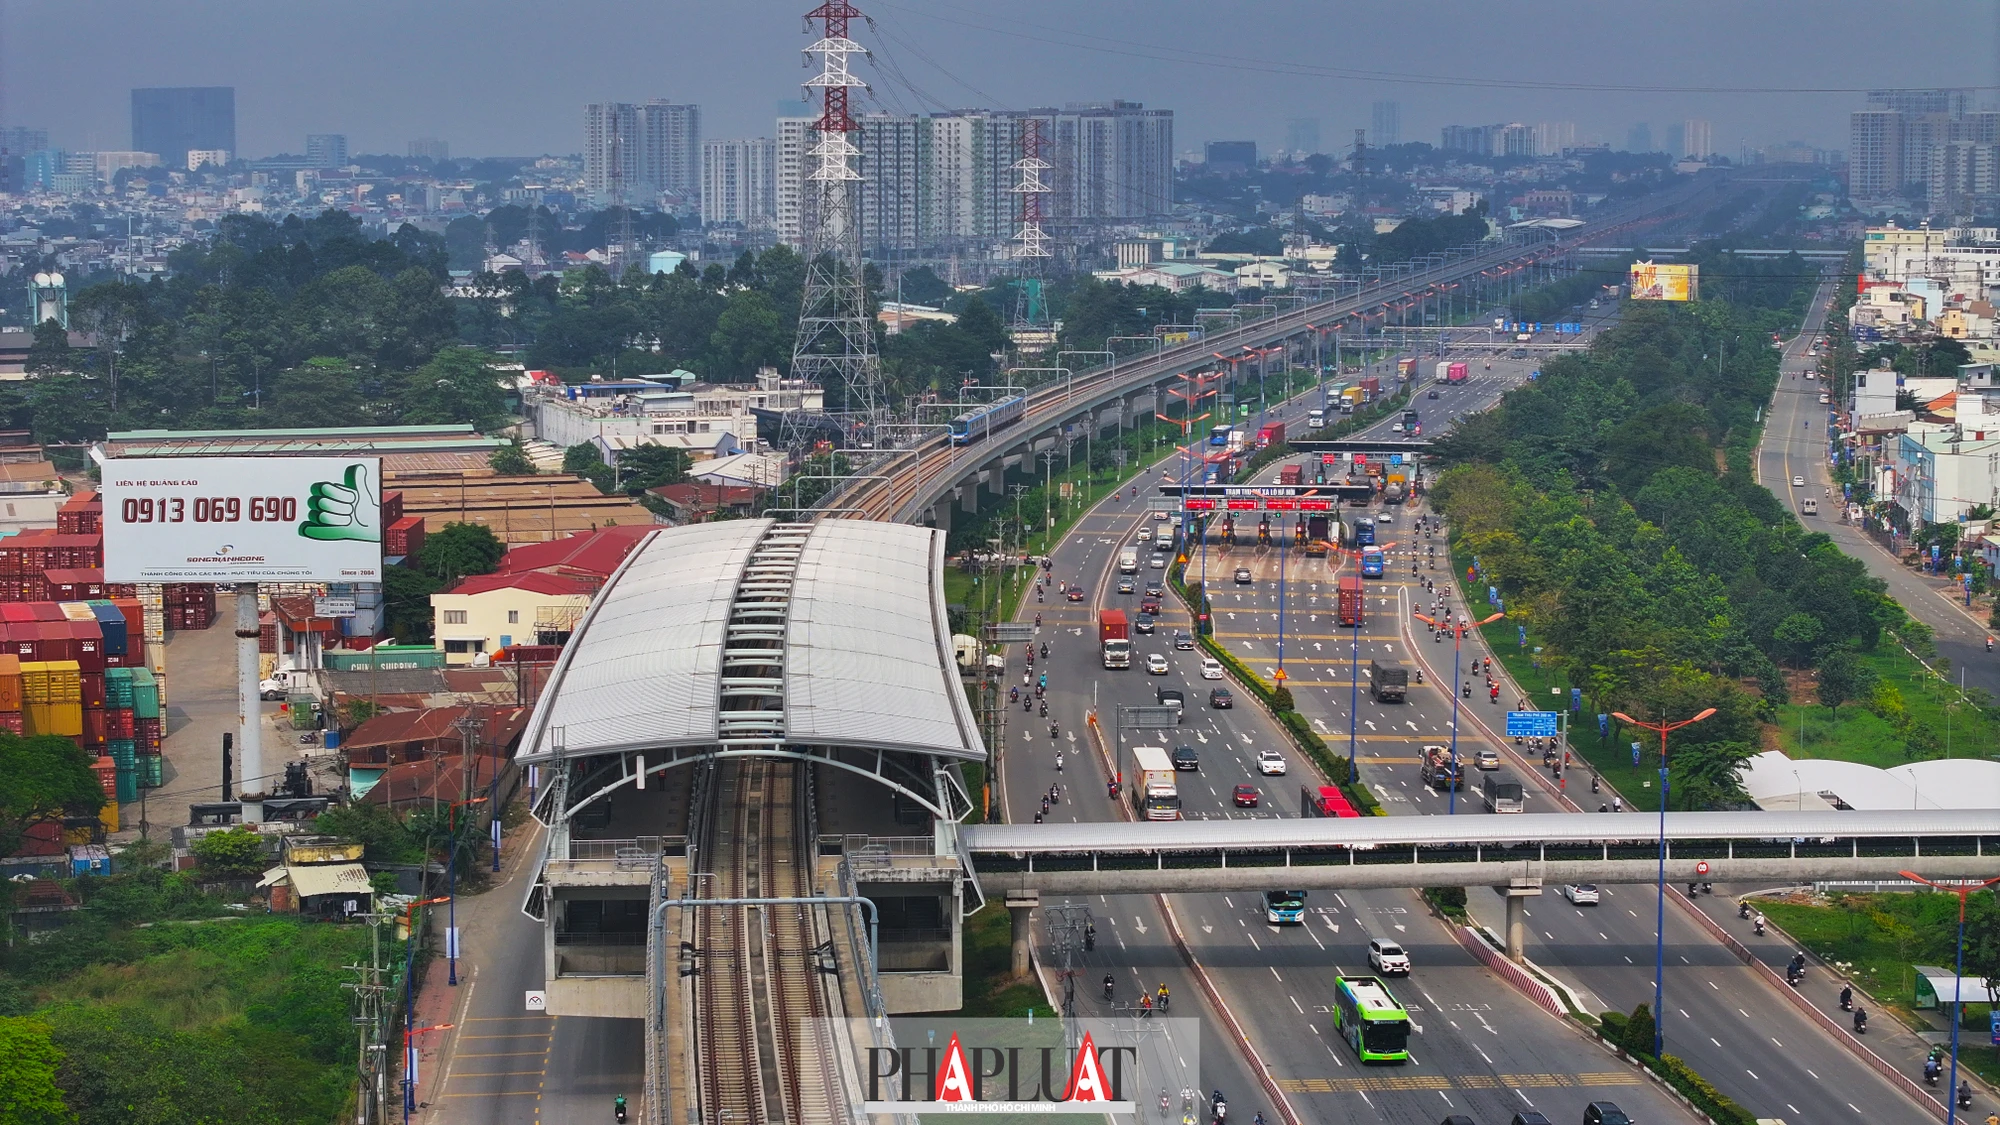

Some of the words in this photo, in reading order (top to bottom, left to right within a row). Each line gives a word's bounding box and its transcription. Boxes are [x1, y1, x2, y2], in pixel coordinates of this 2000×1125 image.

[122, 497, 185, 523] 0913
[193, 496, 241, 523] 069
[248, 496, 297, 522] 690
